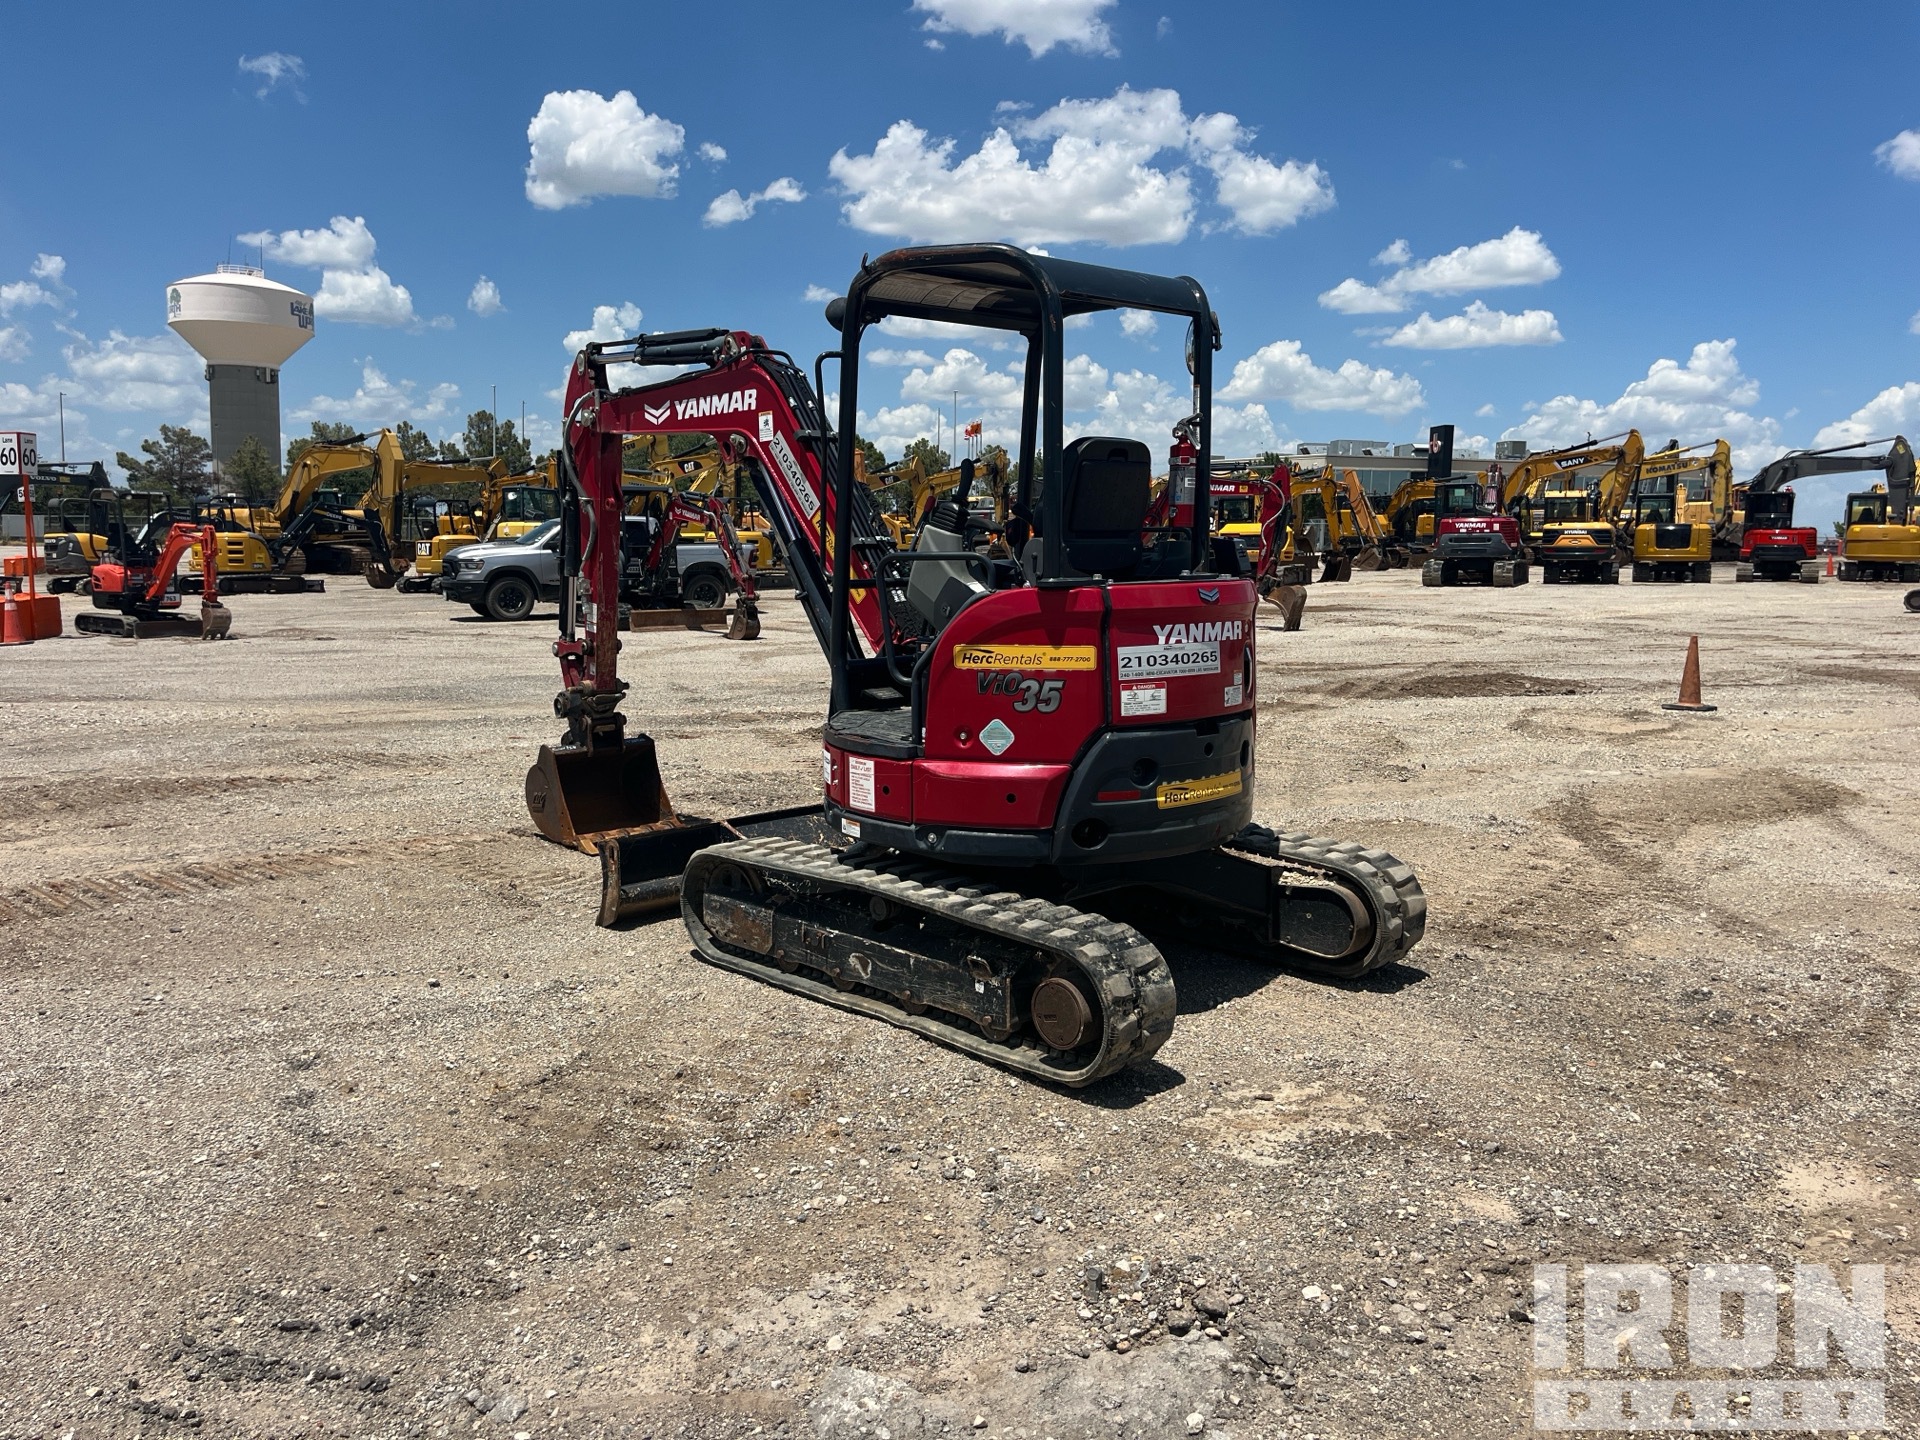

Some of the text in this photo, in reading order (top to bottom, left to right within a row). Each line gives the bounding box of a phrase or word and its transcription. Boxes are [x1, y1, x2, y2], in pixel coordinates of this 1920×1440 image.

[674, 388, 757, 421] YANMAR
[0, 447, 17, 466] 60
[23, 448, 36, 467] 60
[1560, 457, 1585, 468] SANY
[684, 461, 695, 473] CAT
[772, 437, 815, 511] 210340265
[1646, 461, 1688, 474] KOMATSU
[681, 509, 701, 521] YANMAR
[417, 541, 430, 556] CAT
[1152, 620, 1243, 645] YANMAR
[961, 651, 1043, 666] HercRentals
[1120, 650, 1218, 669] 210340265
[1164, 784, 1222, 804] HercRentals
